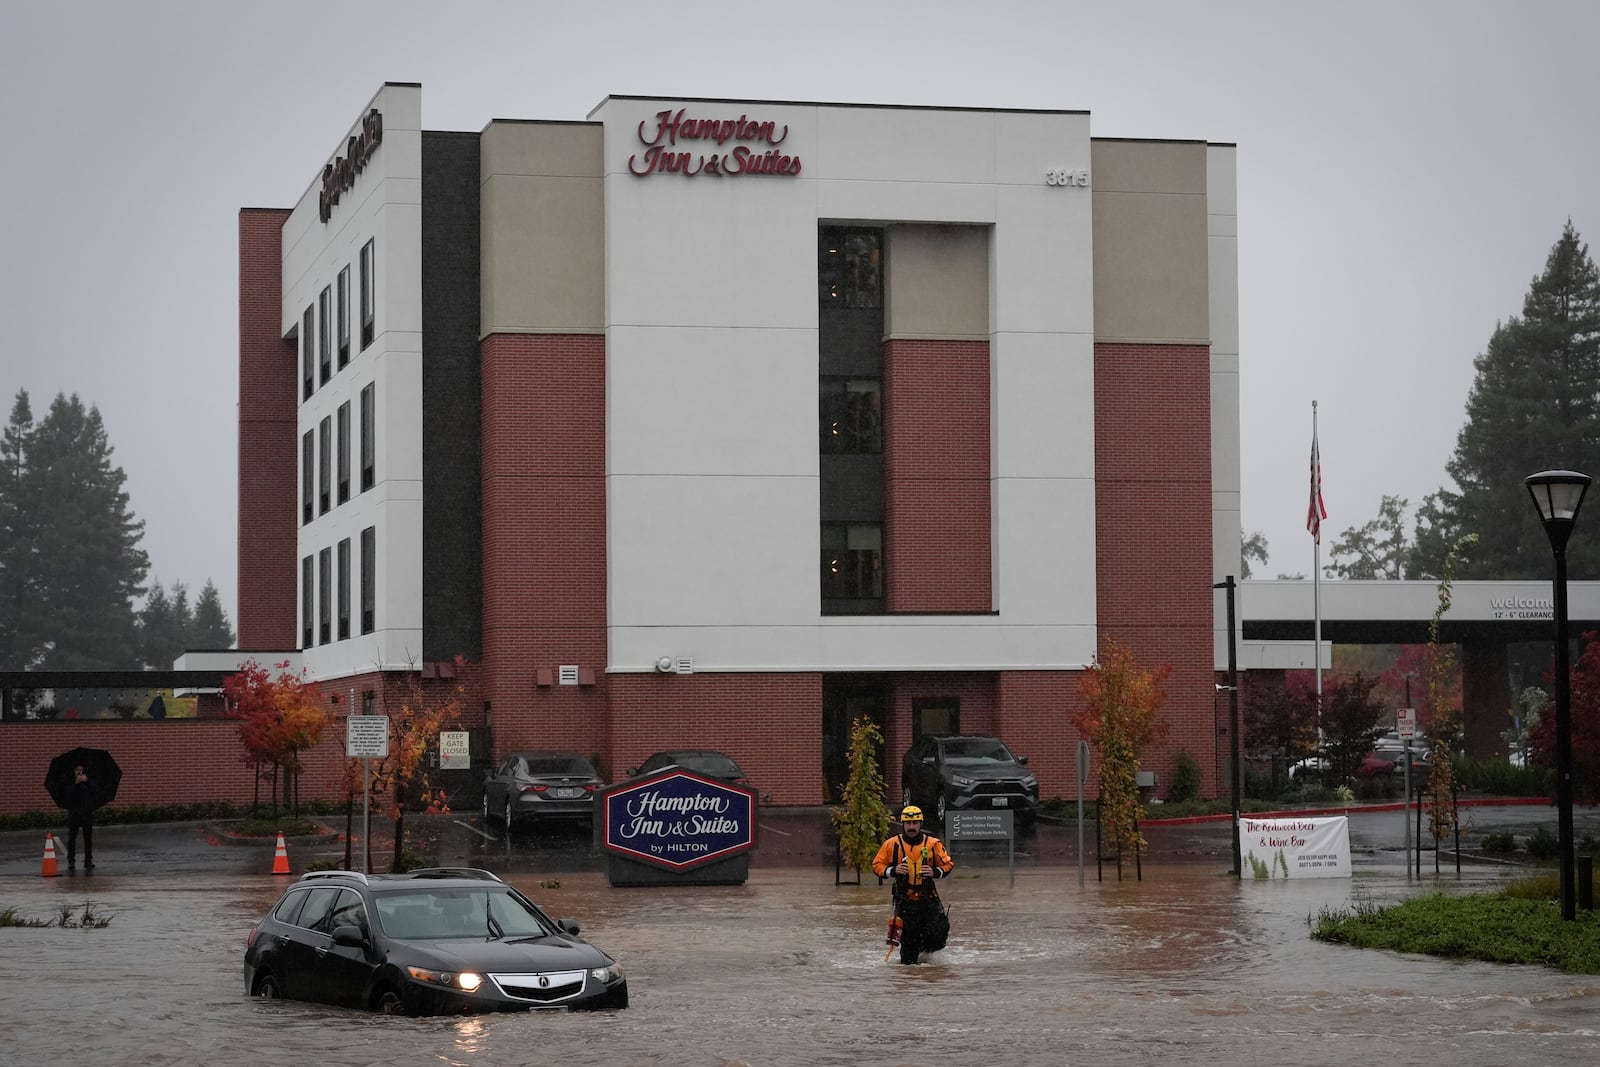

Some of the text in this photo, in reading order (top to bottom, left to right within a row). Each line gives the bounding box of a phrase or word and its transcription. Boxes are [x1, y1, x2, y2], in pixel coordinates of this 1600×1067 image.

[638, 108, 788, 146] Hampton
[629, 145, 802, 177] Inn & Suites
[1047, 168, 1088, 187] 3815
[627, 791, 730, 817] Hampton
[620, 815, 739, 838] Inn & Suites
[1245, 821, 1317, 833] The Redwood Beer
[651, 843, 708, 854] by HILTON
[1259, 835, 1307, 847] & Wine Bar
